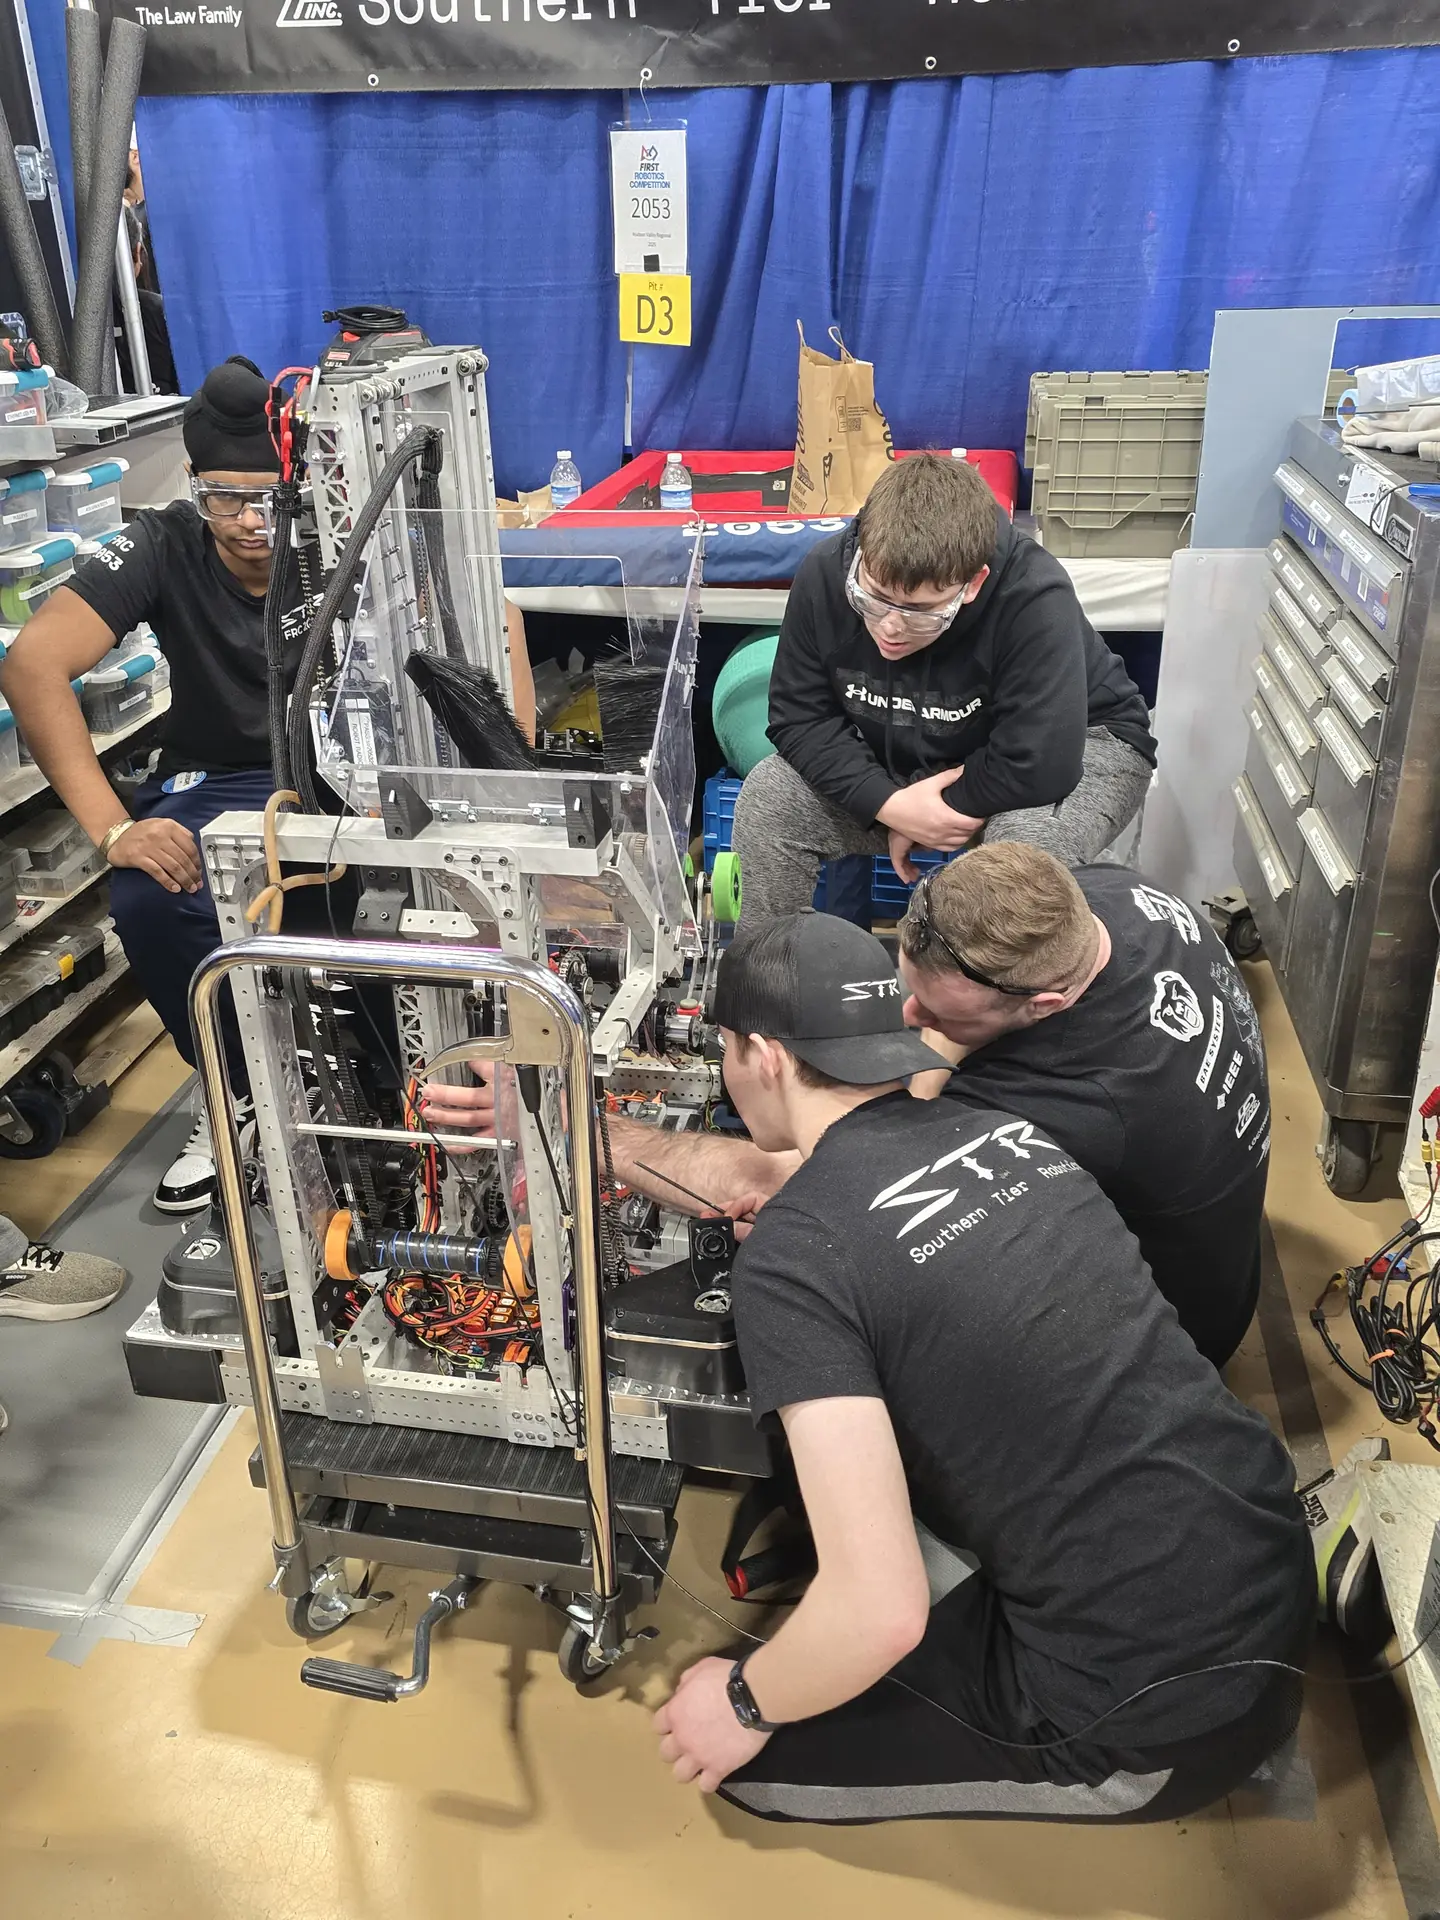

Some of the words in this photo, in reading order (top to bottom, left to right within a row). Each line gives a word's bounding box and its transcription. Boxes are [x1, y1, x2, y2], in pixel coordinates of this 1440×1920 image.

[135, 7, 163, 26] The
[165, 7, 196, 25] Law
[198, 6, 242, 28] Family
[304, 2, 342, 19] INC.
[634, 172, 665, 180] ROBOTICS
[640, 163, 659, 172] FIRST
[629, 181, 671, 189] COMPETITION
[631, 197, 671, 219] 2053
[648, 281, 657, 291] Pit
[637, 294, 673, 336] D3
[92, 548, 124, 571] 053
[921, 697, 982, 722] ARMOUR
[1200, 1061, 1211, 1085] BAE
[1209, 1003, 1222, 1059] SYSTEMS
[1222, 1050, 1244, 1095] IEEE
[909, 1207, 989, 1264] Southern
[991, 1180, 1030, 1206] Tier
